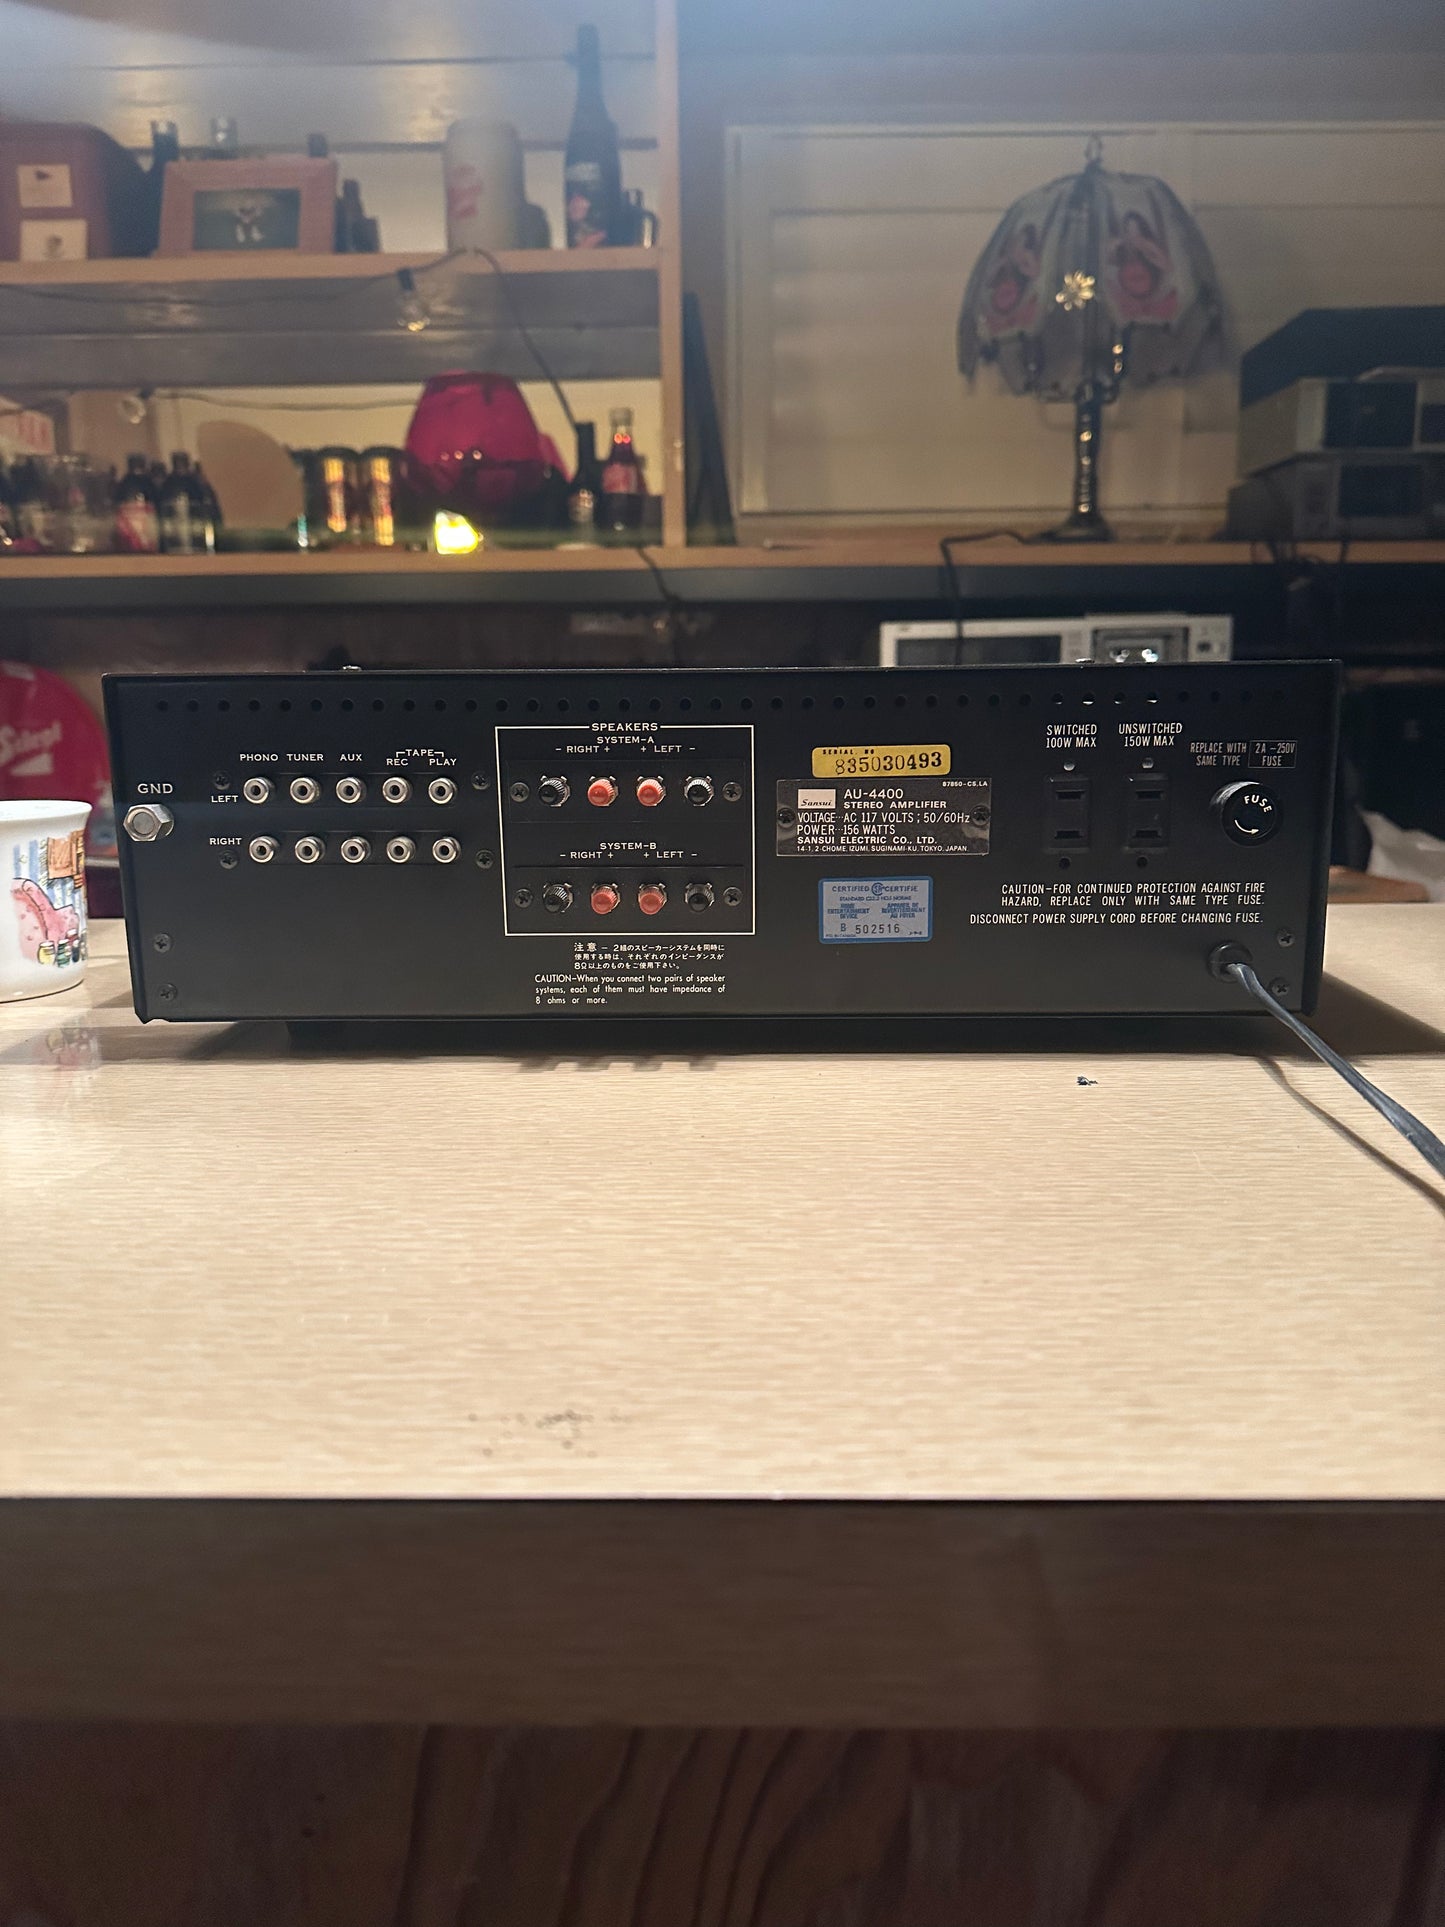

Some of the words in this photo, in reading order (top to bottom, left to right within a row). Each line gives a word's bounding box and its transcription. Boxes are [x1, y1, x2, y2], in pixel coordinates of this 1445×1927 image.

[591, 722, 658, 732] SPEAKERS
[1046, 724, 1097, 736] SWITCHED
[1118, 722, 1183, 734] UNSWITCHED
[596, 736, 654, 744] SYSTEM-A
[1046, 737, 1072, 748] 100W
[1075, 737, 1097, 748] MAX
[1124, 736, 1151, 747] 150W
[1153, 735, 1175, 746] MAX
[405, 749, 434, 757] TAPE
[566, 745, 600, 754] RIGHT
[654, 745, 682, 753] LEFT
[1190, 742, 1224, 754] REPLACE
[1226, 742, 1248, 753] WITH
[1255, 743, 1267, 754] 2A
[240, 753, 279, 762] PHONO
[286, 753, 324, 762] TUNER
[340, 753, 362, 762] AUX
[386, 758, 409, 766] REC
[429, 758, 458, 766] PLAY
[1196, 756, 1218, 766] SAME
[1222, 755, 1242, 766] TYPE
[1262, 755, 1283, 766] FUSE
[835, 752, 942, 774] 835030493
[137, 783, 174, 795] GND
[843, 788, 904, 800] AU-4400
[211, 795, 239, 804] LEFT
[800, 798, 833, 807] Sansui
[1244, 794, 1273, 813] FUSE
[843, 801, 884, 810] STEREO
[890, 800, 948, 810] AMPLIFIER
[861, 812, 877, 823] 117
[881, 812, 914, 823] VOLTS
[923, 812, 970, 824] 50/60Hz
[862, 824, 896, 836] WATTS
[209, 837, 242, 846] RIGHT
[797, 836, 835, 844] SANSUI
[840, 836, 887, 844] ELECTRIC
[916, 836, 938, 844] LTD.
[600, 842, 657, 850] SYSTEM-B
[570, 851, 602, 860] RIGHT
[656, 851, 684, 859] LEFT
[1077, 884, 1132, 894] CONTINUED
[1136, 882, 1197, 894] PROTECTION
[1200, 882, 1241, 893] AGAINST
[1244, 882, 1266, 893] FIRE
[1050, 896, 1092, 906] REPLACE
[1102, 896, 1126, 906] ONLY
[1134, 896, 1160, 906] WITH
[1170, 895, 1196, 906] SAME
[1205, 895, 1229, 905] TYPE
[1237, 894, 1265, 905] FUSE.
[970, 914, 1029, 924] DISCONNECT
[1032, 914, 1066, 924] POWER
[1070, 914, 1106, 924] SUPPLY
[1110, 913, 1136, 924] CORD
[1140, 913, 1177, 924] BEFORE
[1181, 912, 1232, 924] CHANGING
[1236, 912, 1264, 923] FUSE.
[855, 923, 900, 934] 502516
[601, 976, 616, 984] you
[617, 974, 645, 982] connect
[648, 974, 662, 982] two
[664, 974, 684, 984] pairs
[686, 974, 694, 982] of
[696, 974, 726, 984] speaker
[536, 986, 566, 995] systems,
[570, 985, 588, 994] each
[592, 985, 600, 994] of
[605, 985, 623, 993] them
[628, 985, 645, 993] must
[650, 985, 668, 993] have
[672, 984, 712, 994] impedance
[718, 984, 726, 993] of
[535, 996, 541, 1004] 8
[547, 996, 566, 1004] ohms
